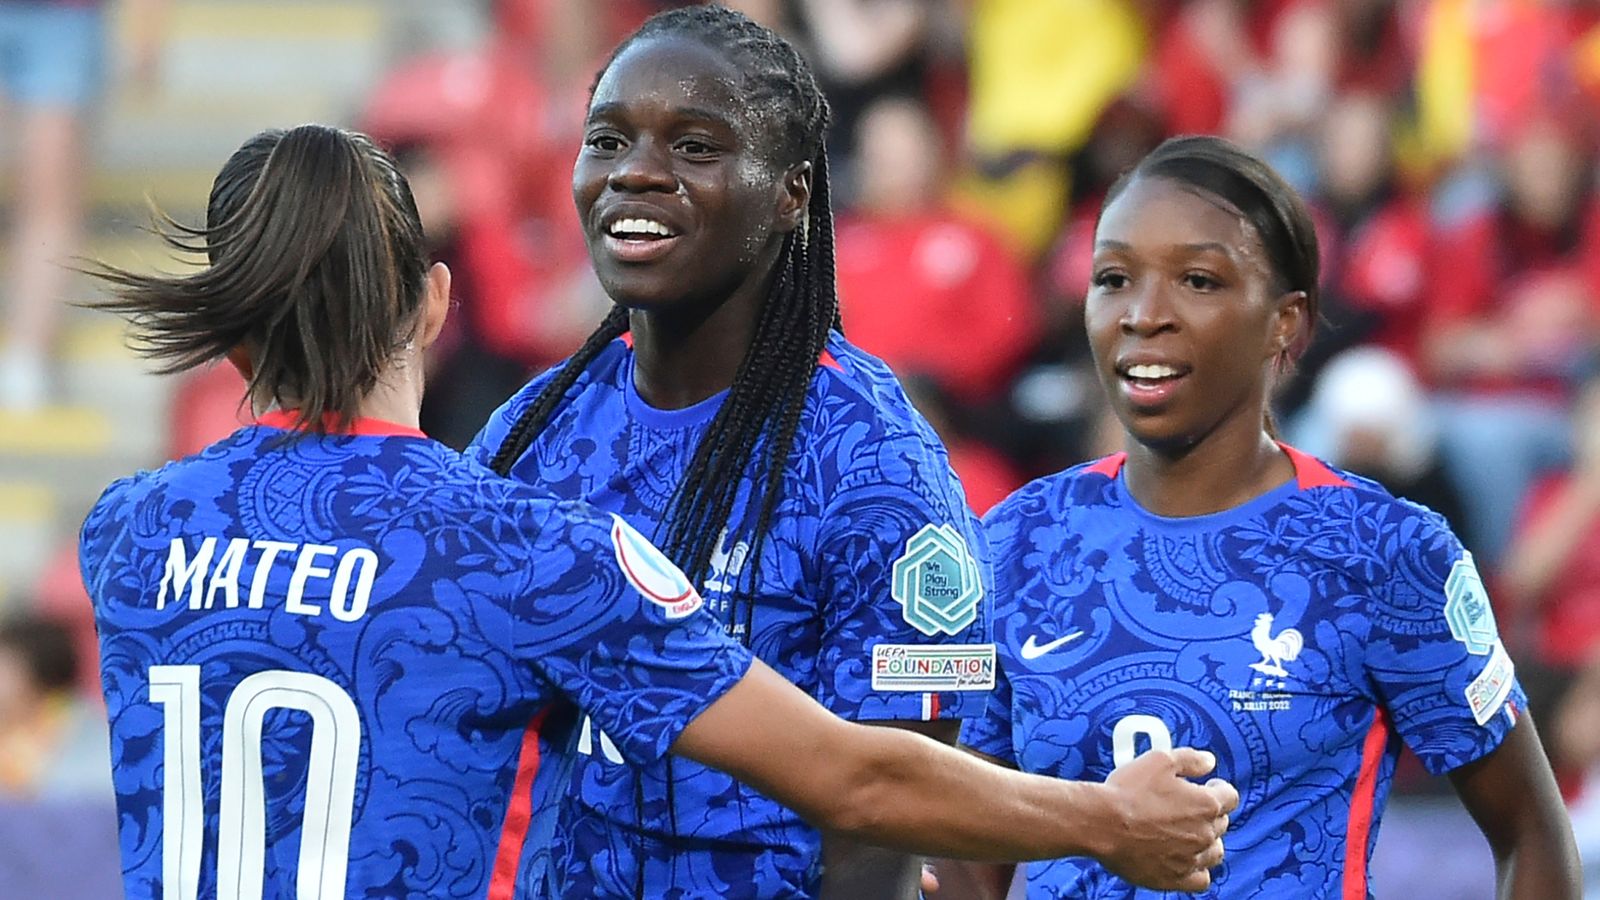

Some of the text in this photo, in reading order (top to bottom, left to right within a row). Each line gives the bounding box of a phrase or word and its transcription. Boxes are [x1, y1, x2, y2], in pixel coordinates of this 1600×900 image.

[925, 562, 941, 572] We
[157, 537, 378, 622] MATEO
[925, 574, 947, 586] Play
[925, 587, 959, 598] Strong
[877, 647, 906, 658] UEFA
[877, 658, 993, 675] FOUNDATION
[1268, 700, 1291, 710] 2022
[148, 664, 361, 900] 10
